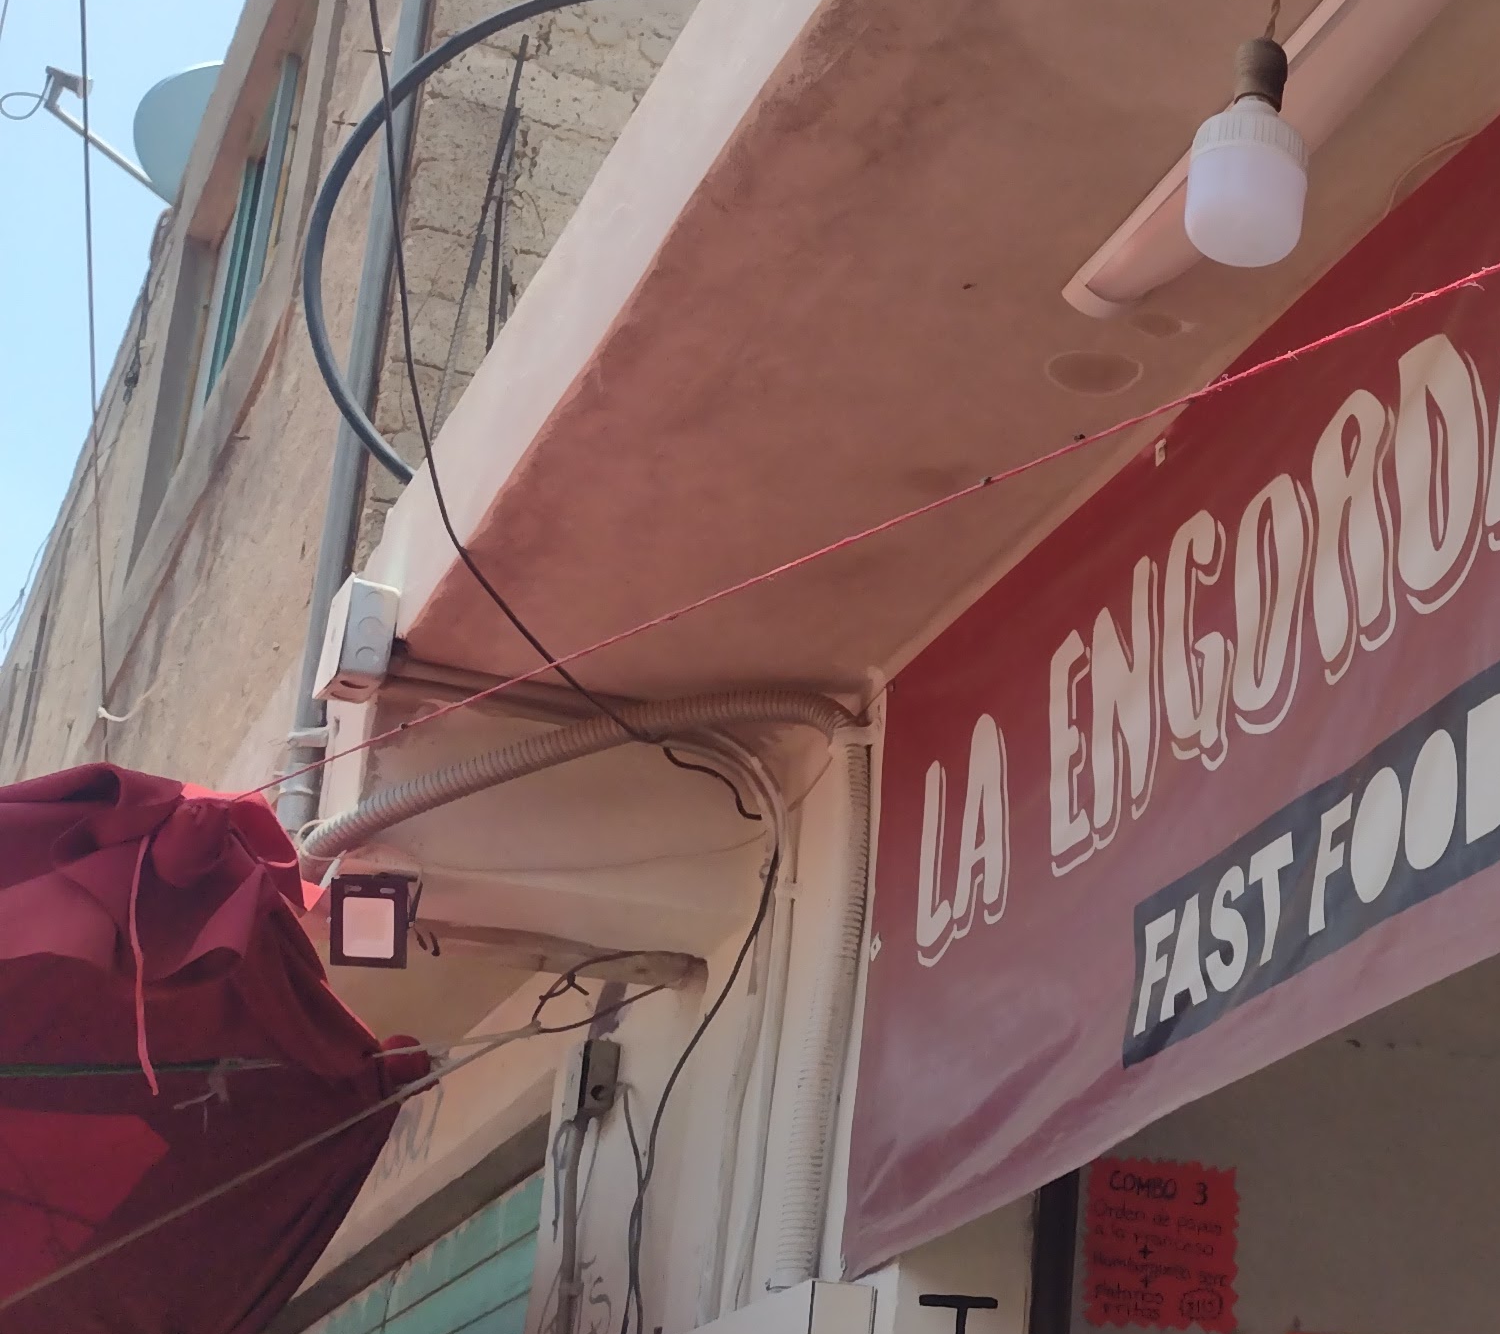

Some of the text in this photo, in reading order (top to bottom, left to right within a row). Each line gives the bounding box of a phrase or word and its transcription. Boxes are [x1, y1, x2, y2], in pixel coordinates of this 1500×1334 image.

[916, 714, 1009, 966] LA
[1132, 831, 1295, 1036] FAST
[1110, 1170, 1209, 1206] COMBO 3
